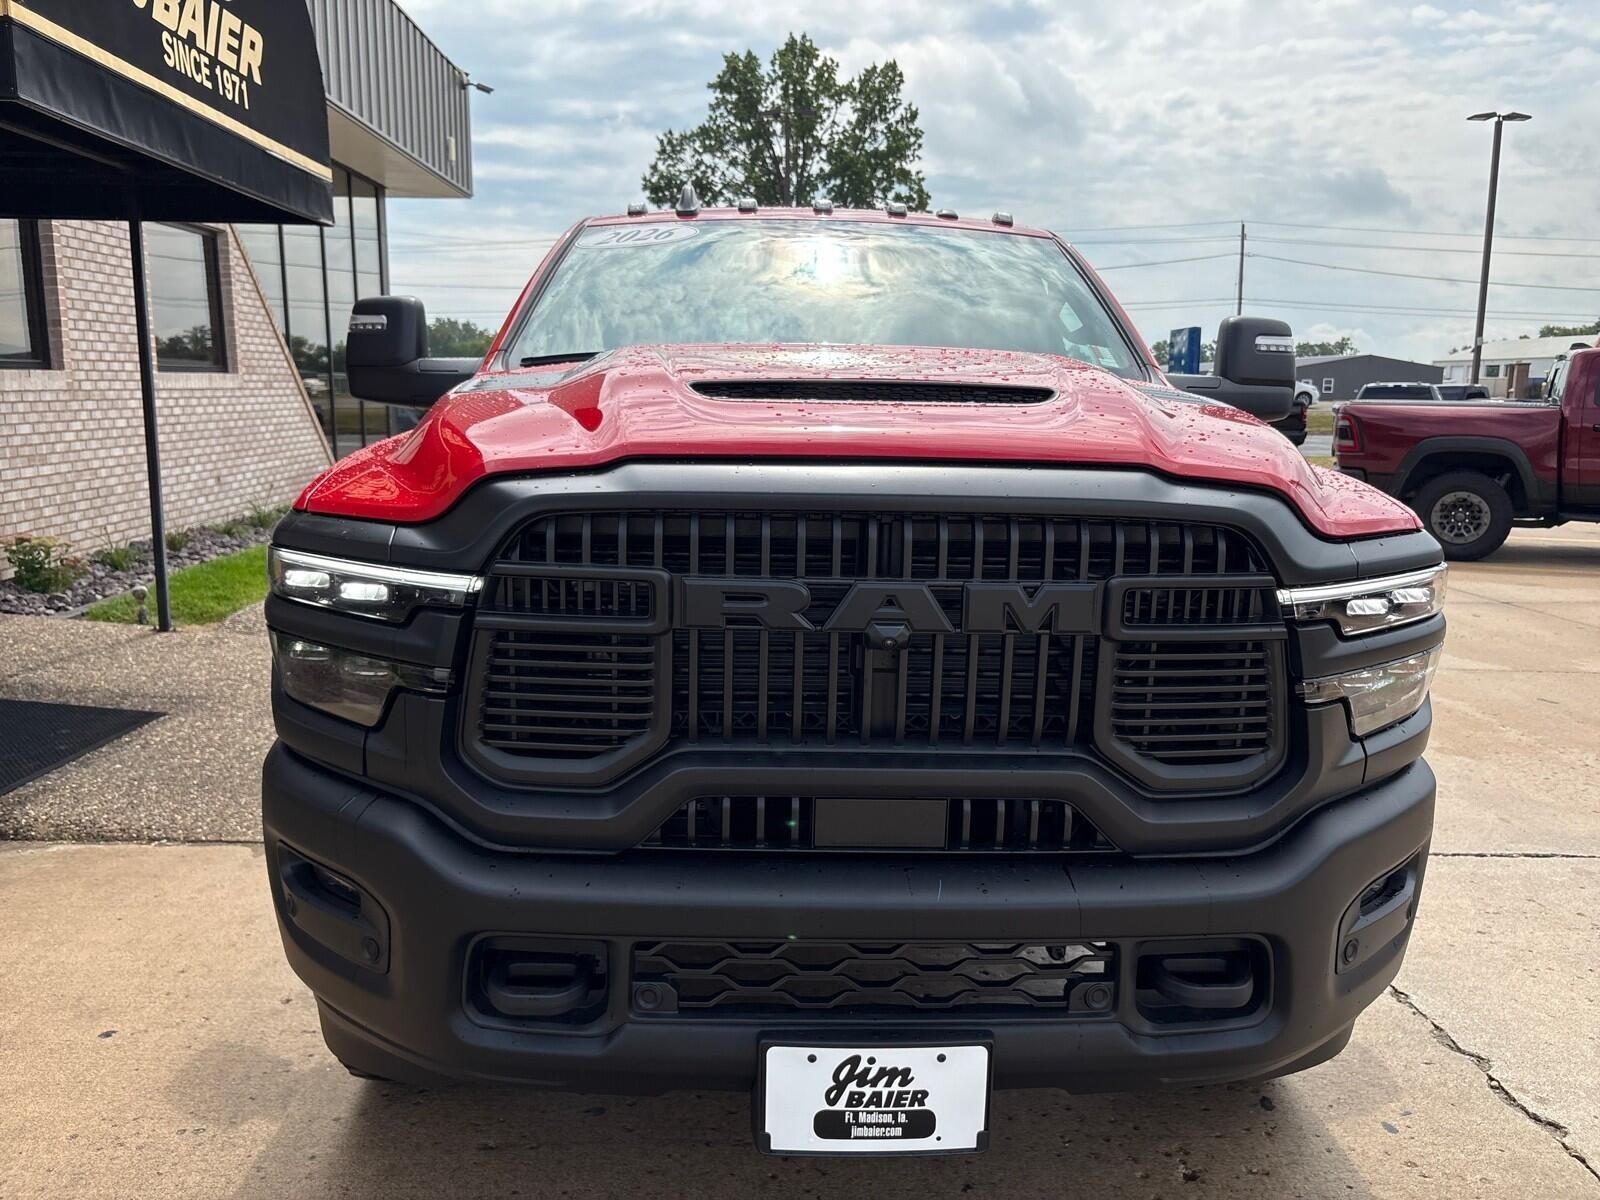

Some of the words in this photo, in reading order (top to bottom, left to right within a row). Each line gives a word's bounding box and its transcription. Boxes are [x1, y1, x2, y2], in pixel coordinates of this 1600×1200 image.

[162, 30, 213, 90] SINCE
[215, 64, 249, 110] 1971
[595, 228, 676, 246] 2026
[681, 577, 1099, 634] RAM
[825, 1054, 915, 1107] Jim
[844, 1089, 929, 1109] BAIER
[845, 1112, 856, 1123] Ft.
[858, 1112, 895, 1124] Madison,
[851, 1125, 902, 1138] jimbaier.com
